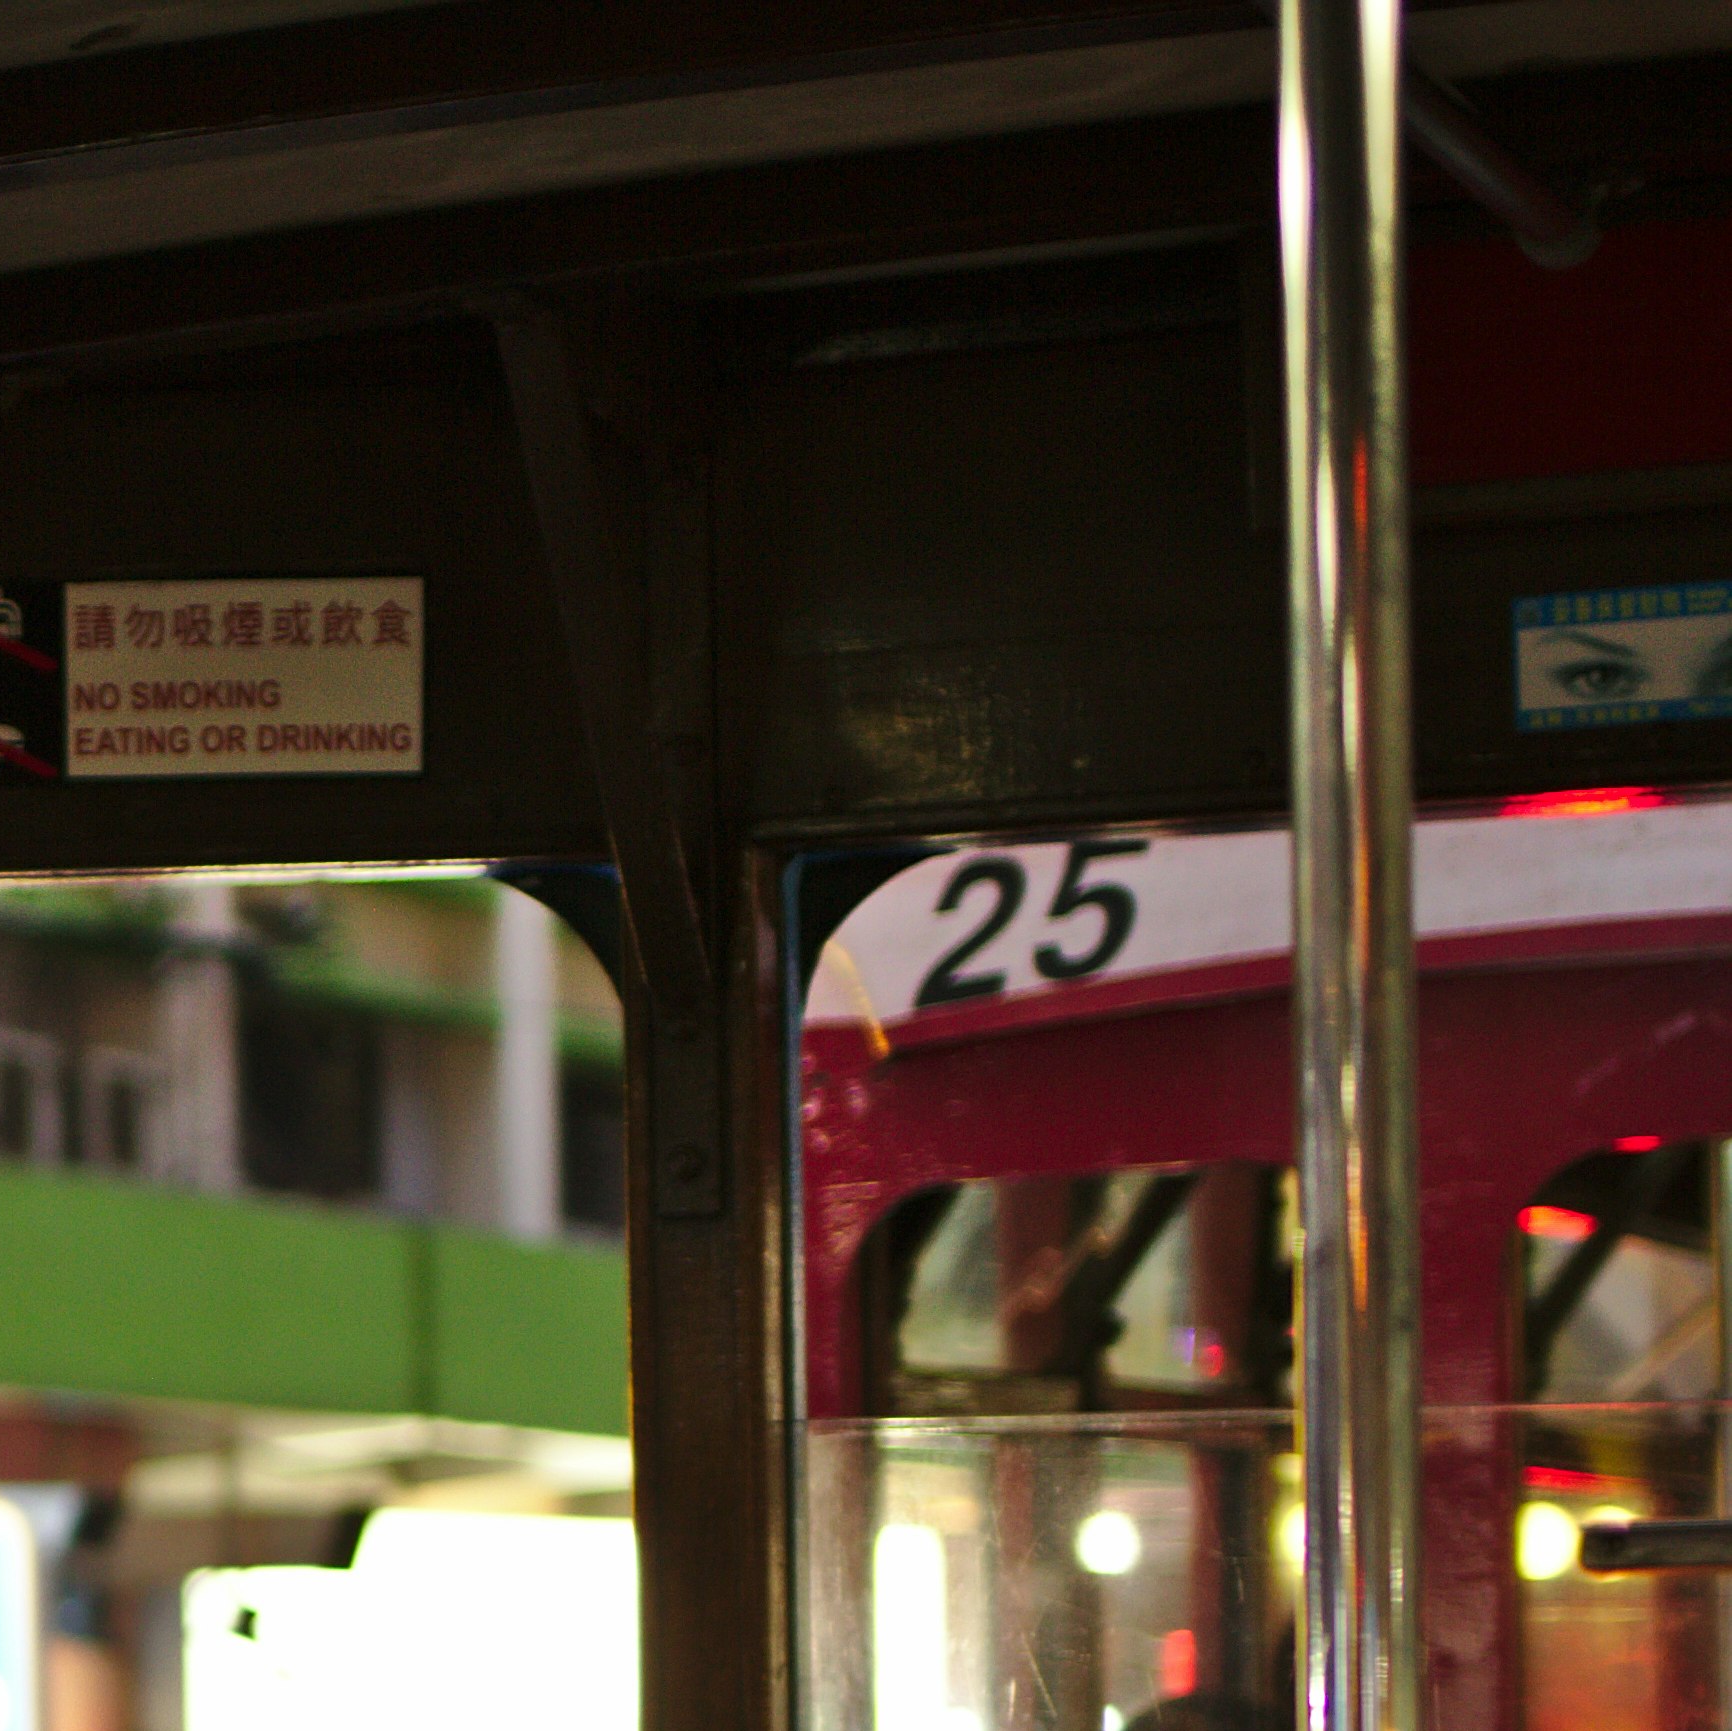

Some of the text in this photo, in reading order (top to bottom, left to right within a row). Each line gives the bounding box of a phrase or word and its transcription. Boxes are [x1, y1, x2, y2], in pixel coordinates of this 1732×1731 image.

[73, 598, 412, 651] 請勿吸煙或飲食
[73, 679, 282, 711] NO SMOKING
[73, 722, 413, 756] EATING OR DRINKING
[915, 839, 1150, 1008] 25
